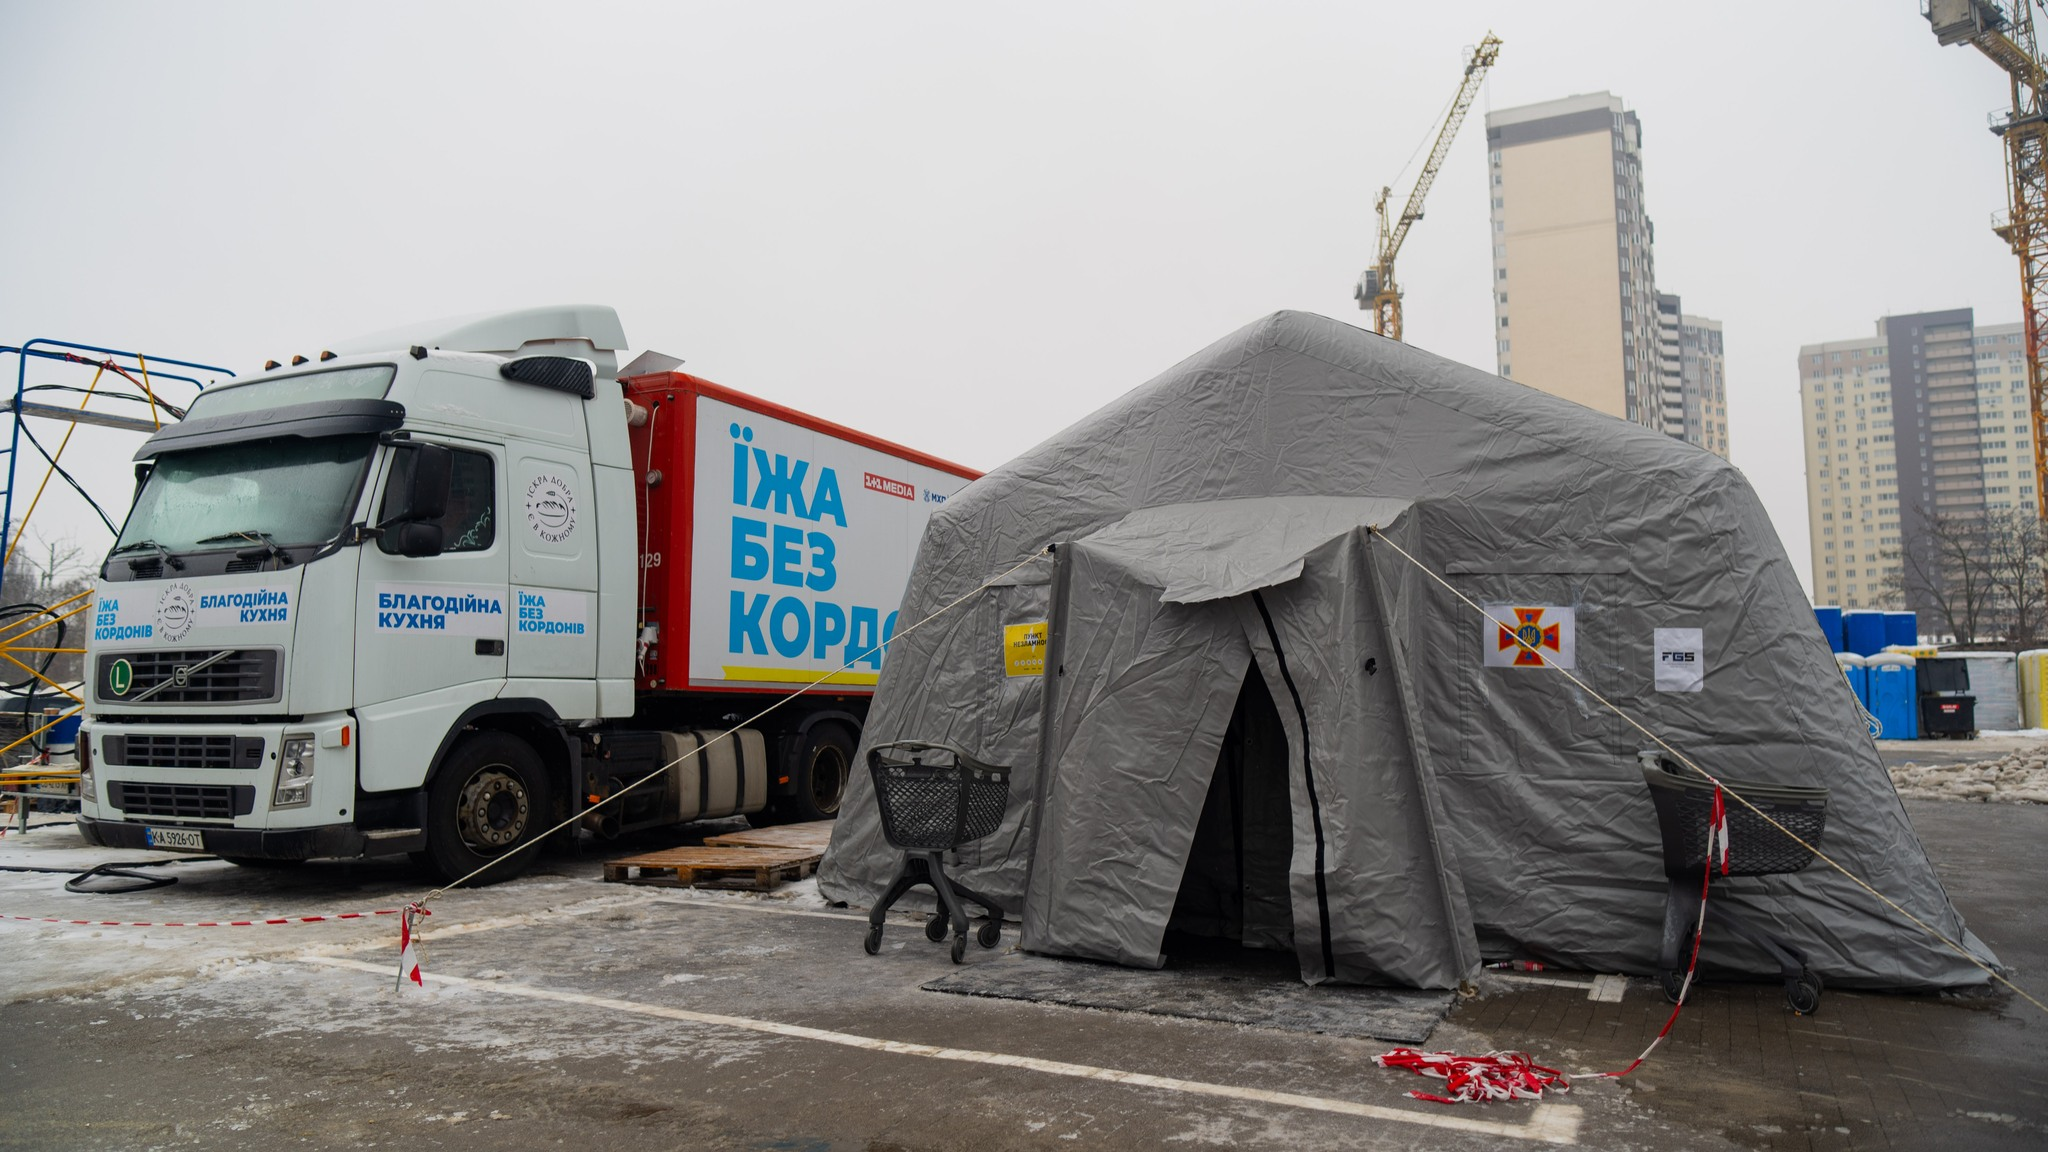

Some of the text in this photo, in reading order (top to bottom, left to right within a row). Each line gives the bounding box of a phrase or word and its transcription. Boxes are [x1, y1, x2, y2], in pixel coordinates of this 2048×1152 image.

[729, 422, 848, 528] ЇЖА
[527, 475, 573, 503] ІСКРА ДОБРА
[865, 475, 914, 498] 1+1 MEDIA
[533, 523, 539, 531] В
[540, 516, 576, 543] КОЖНОМУ
[639, 552, 661, 568] 129
[730, 515, 837, 592] БЕЗ
[160, 582, 194, 605] ІСКРА ДОБРА
[200, 589, 289, 609] БЛАГОДІЙНА
[518, 590, 546, 608] ЇЖА
[98, 598, 119, 612] ЇЖА
[378, 593, 502, 614] БЛАГОДІЙНА
[96, 613, 116, 626] БЕЗ
[240, 608, 287, 623] КУХНЯ
[378, 613, 445, 629] КУХНЯ
[518, 608, 543, 619] БЕЗ
[94, 625, 153, 641] КОРДОНІВ
[163, 618, 193, 643] КОЖНОМУ
[518, 620, 585, 635] КОРДОНІВ
[729, 590, 899, 670] КОРД
[1013, 640, 1046, 648] НЕЗЛАМНО
[1662, 652, 1695, 661] FGS
[115, 666, 125, 689] L
[166, 832, 187, 846] 5926
